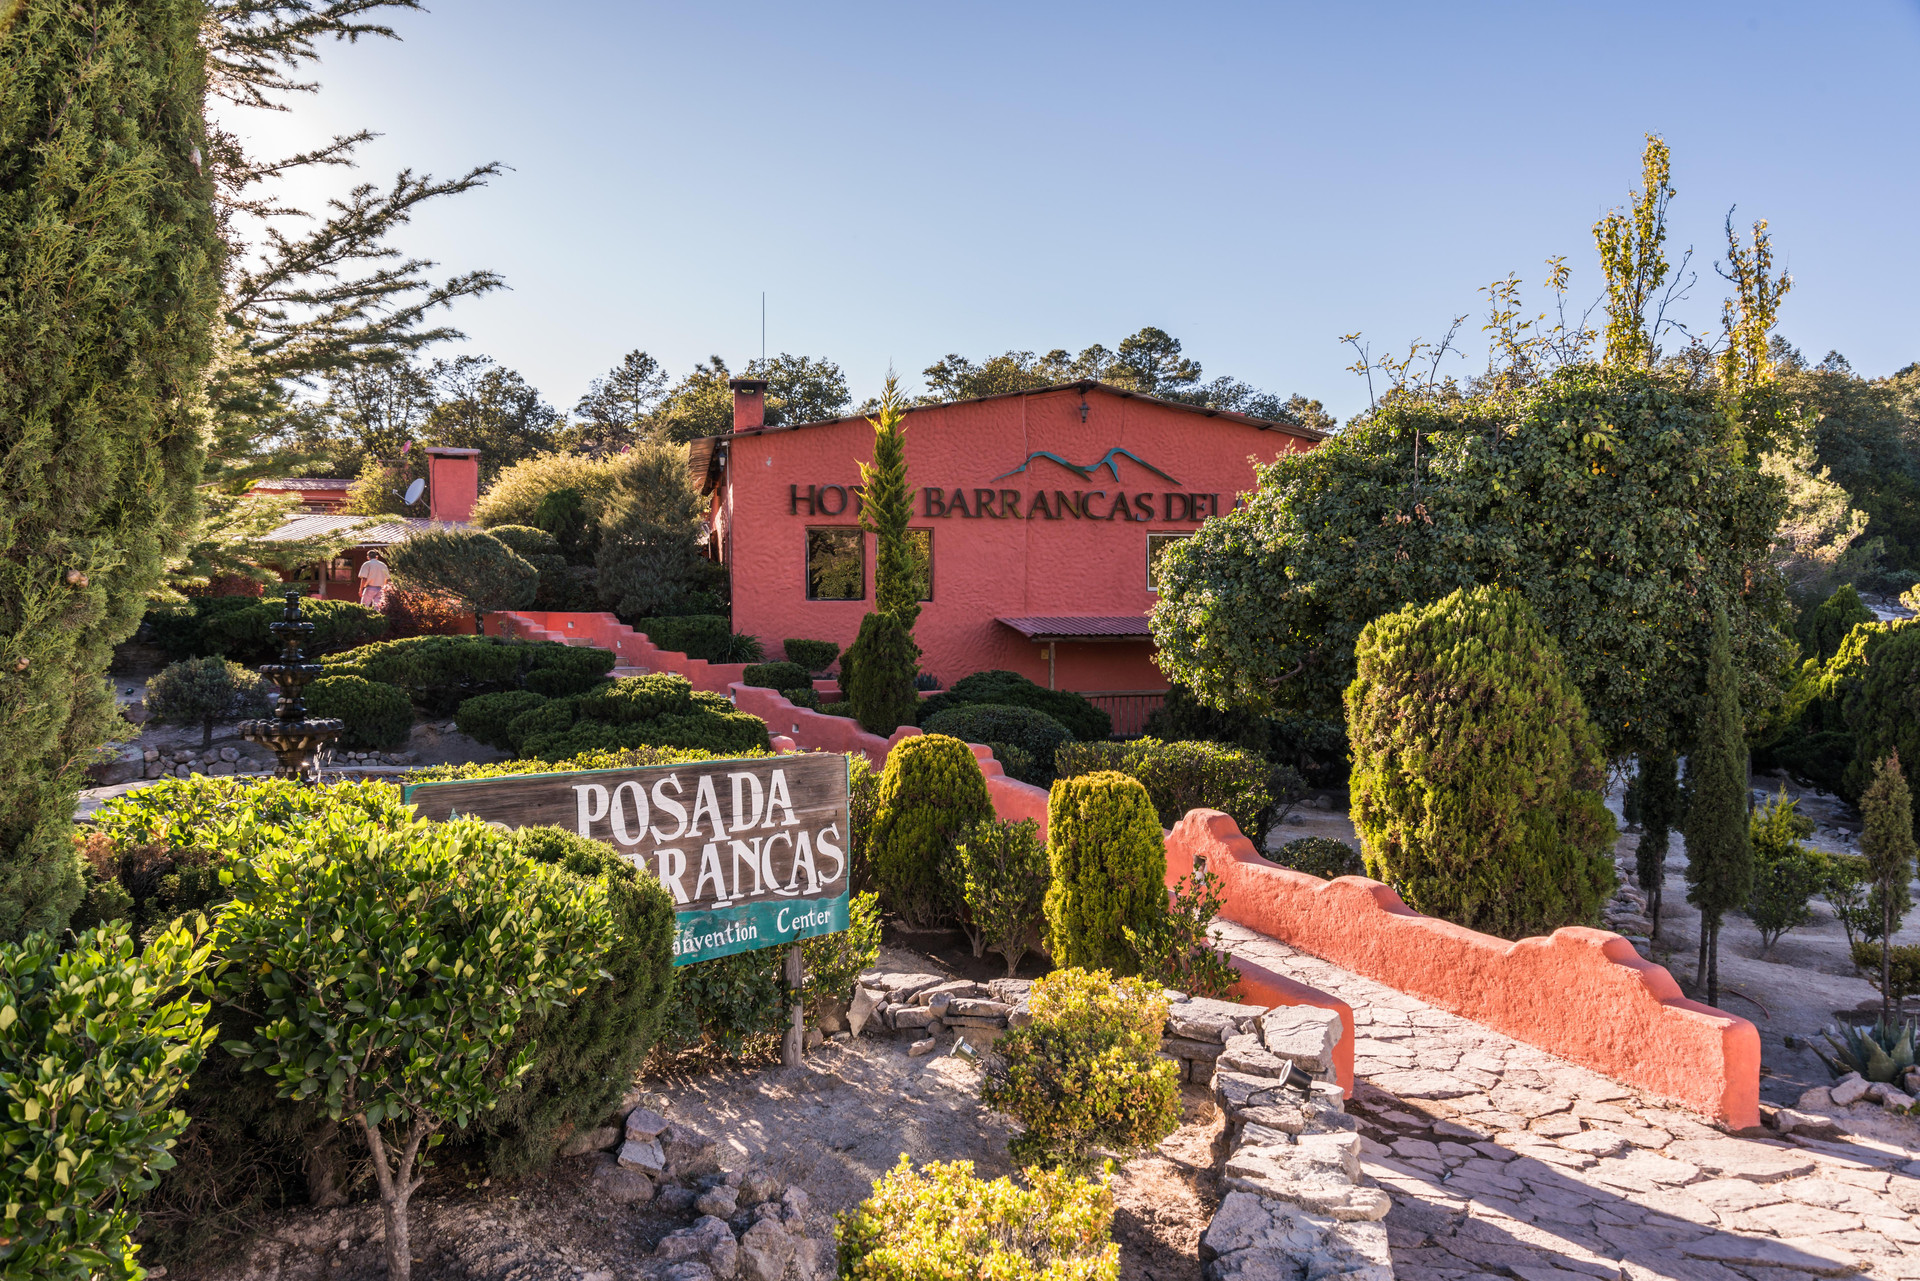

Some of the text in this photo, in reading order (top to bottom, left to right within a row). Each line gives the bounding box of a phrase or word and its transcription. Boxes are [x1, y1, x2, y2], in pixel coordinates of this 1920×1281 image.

[924, 486, 1155, 522] BARRANCAS
[572, 769, 800, 846] POSADA
[621, 822, 845, 909] RANCAS
[672, 906, 831, 956] onvention Center
